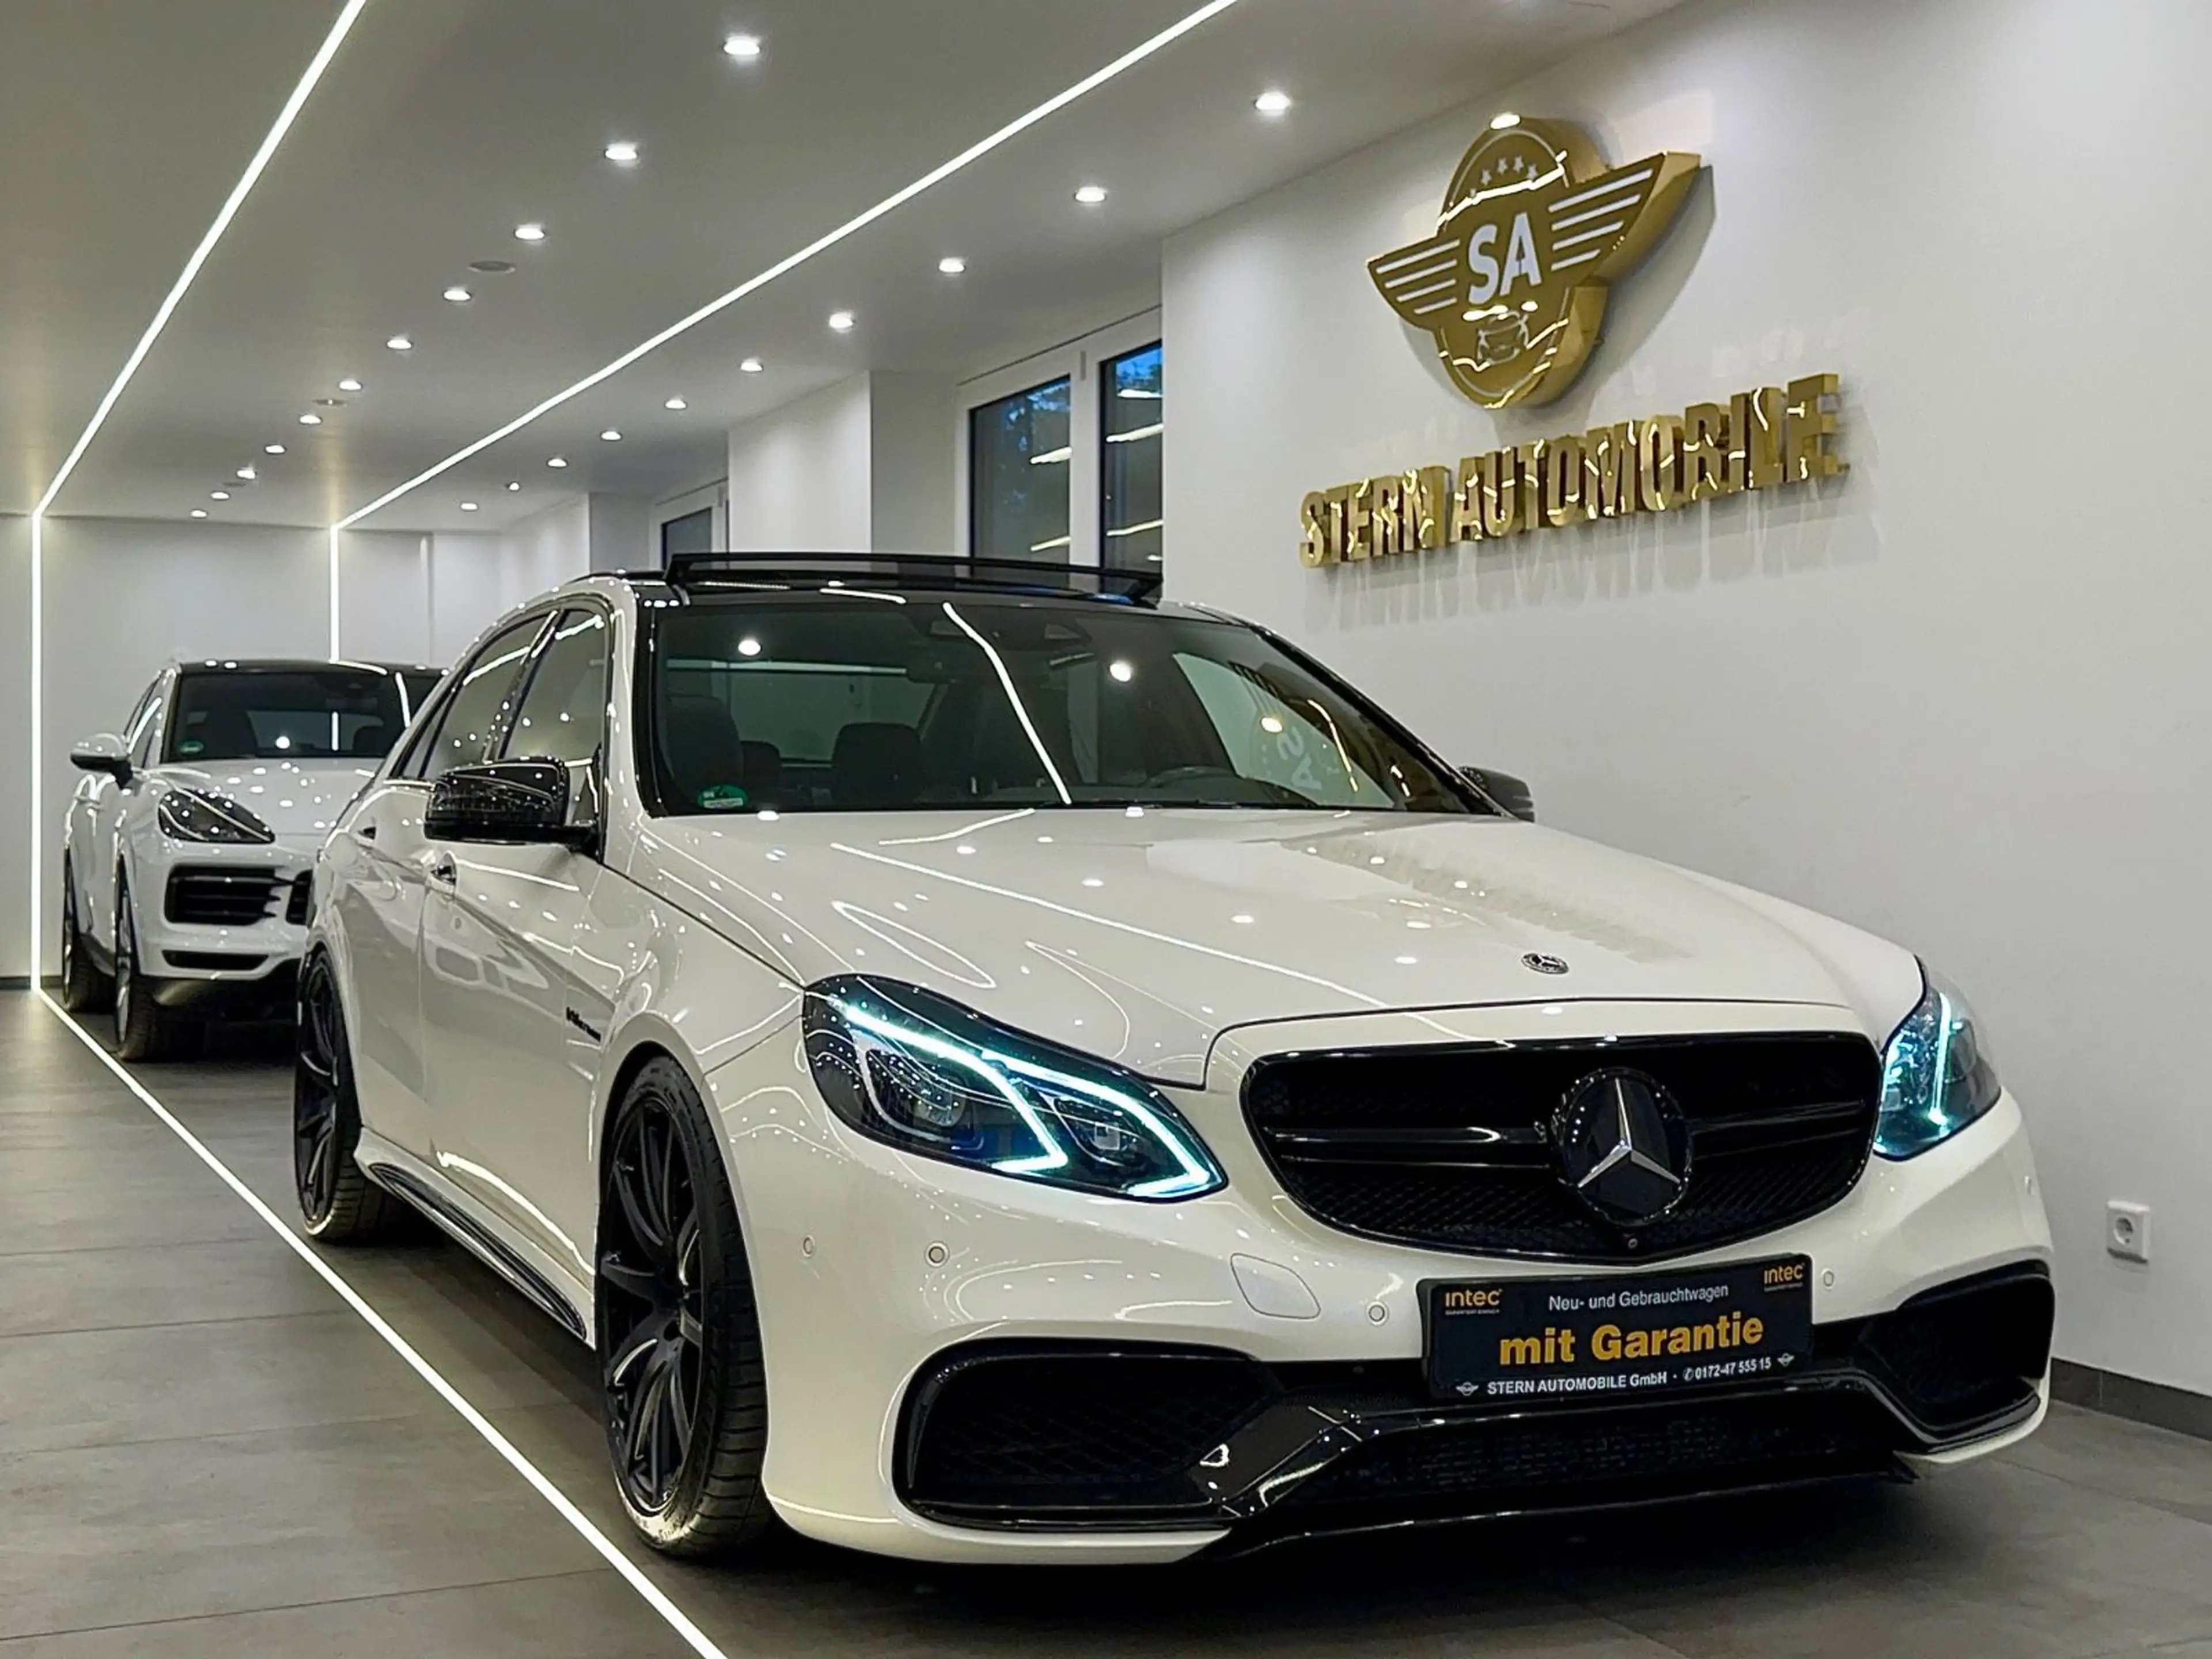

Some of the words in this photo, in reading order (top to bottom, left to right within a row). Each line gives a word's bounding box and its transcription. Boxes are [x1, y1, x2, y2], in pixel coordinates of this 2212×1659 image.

[1468, 213, 1542, 304] SA
[1300, 465, 1448, 568] STERN
[1450, 373, 1839, 543] AUTOMOBILE
[1764, 1264, 1803, 1285] intec
[1445, 1289, 1500, 1308] intec
[1549, 1296, 1585, 1311] Neu-
[1589, 1293, 1615, 1309] und
[1619, 1285, 1728, 1307] Gebrauchtwagen
[1500, 1327, 1576, 1365] mit
[1592, 1311, 1764, 1361] Garantie
[1487, 1381, 1535, 1395] STERN
[1537, 1375, 1627, 1393] AUTOMOBILE
[1630, 1372, 1667, 1387] GmbH
[1759, 1357, 1771, 1371] 15
